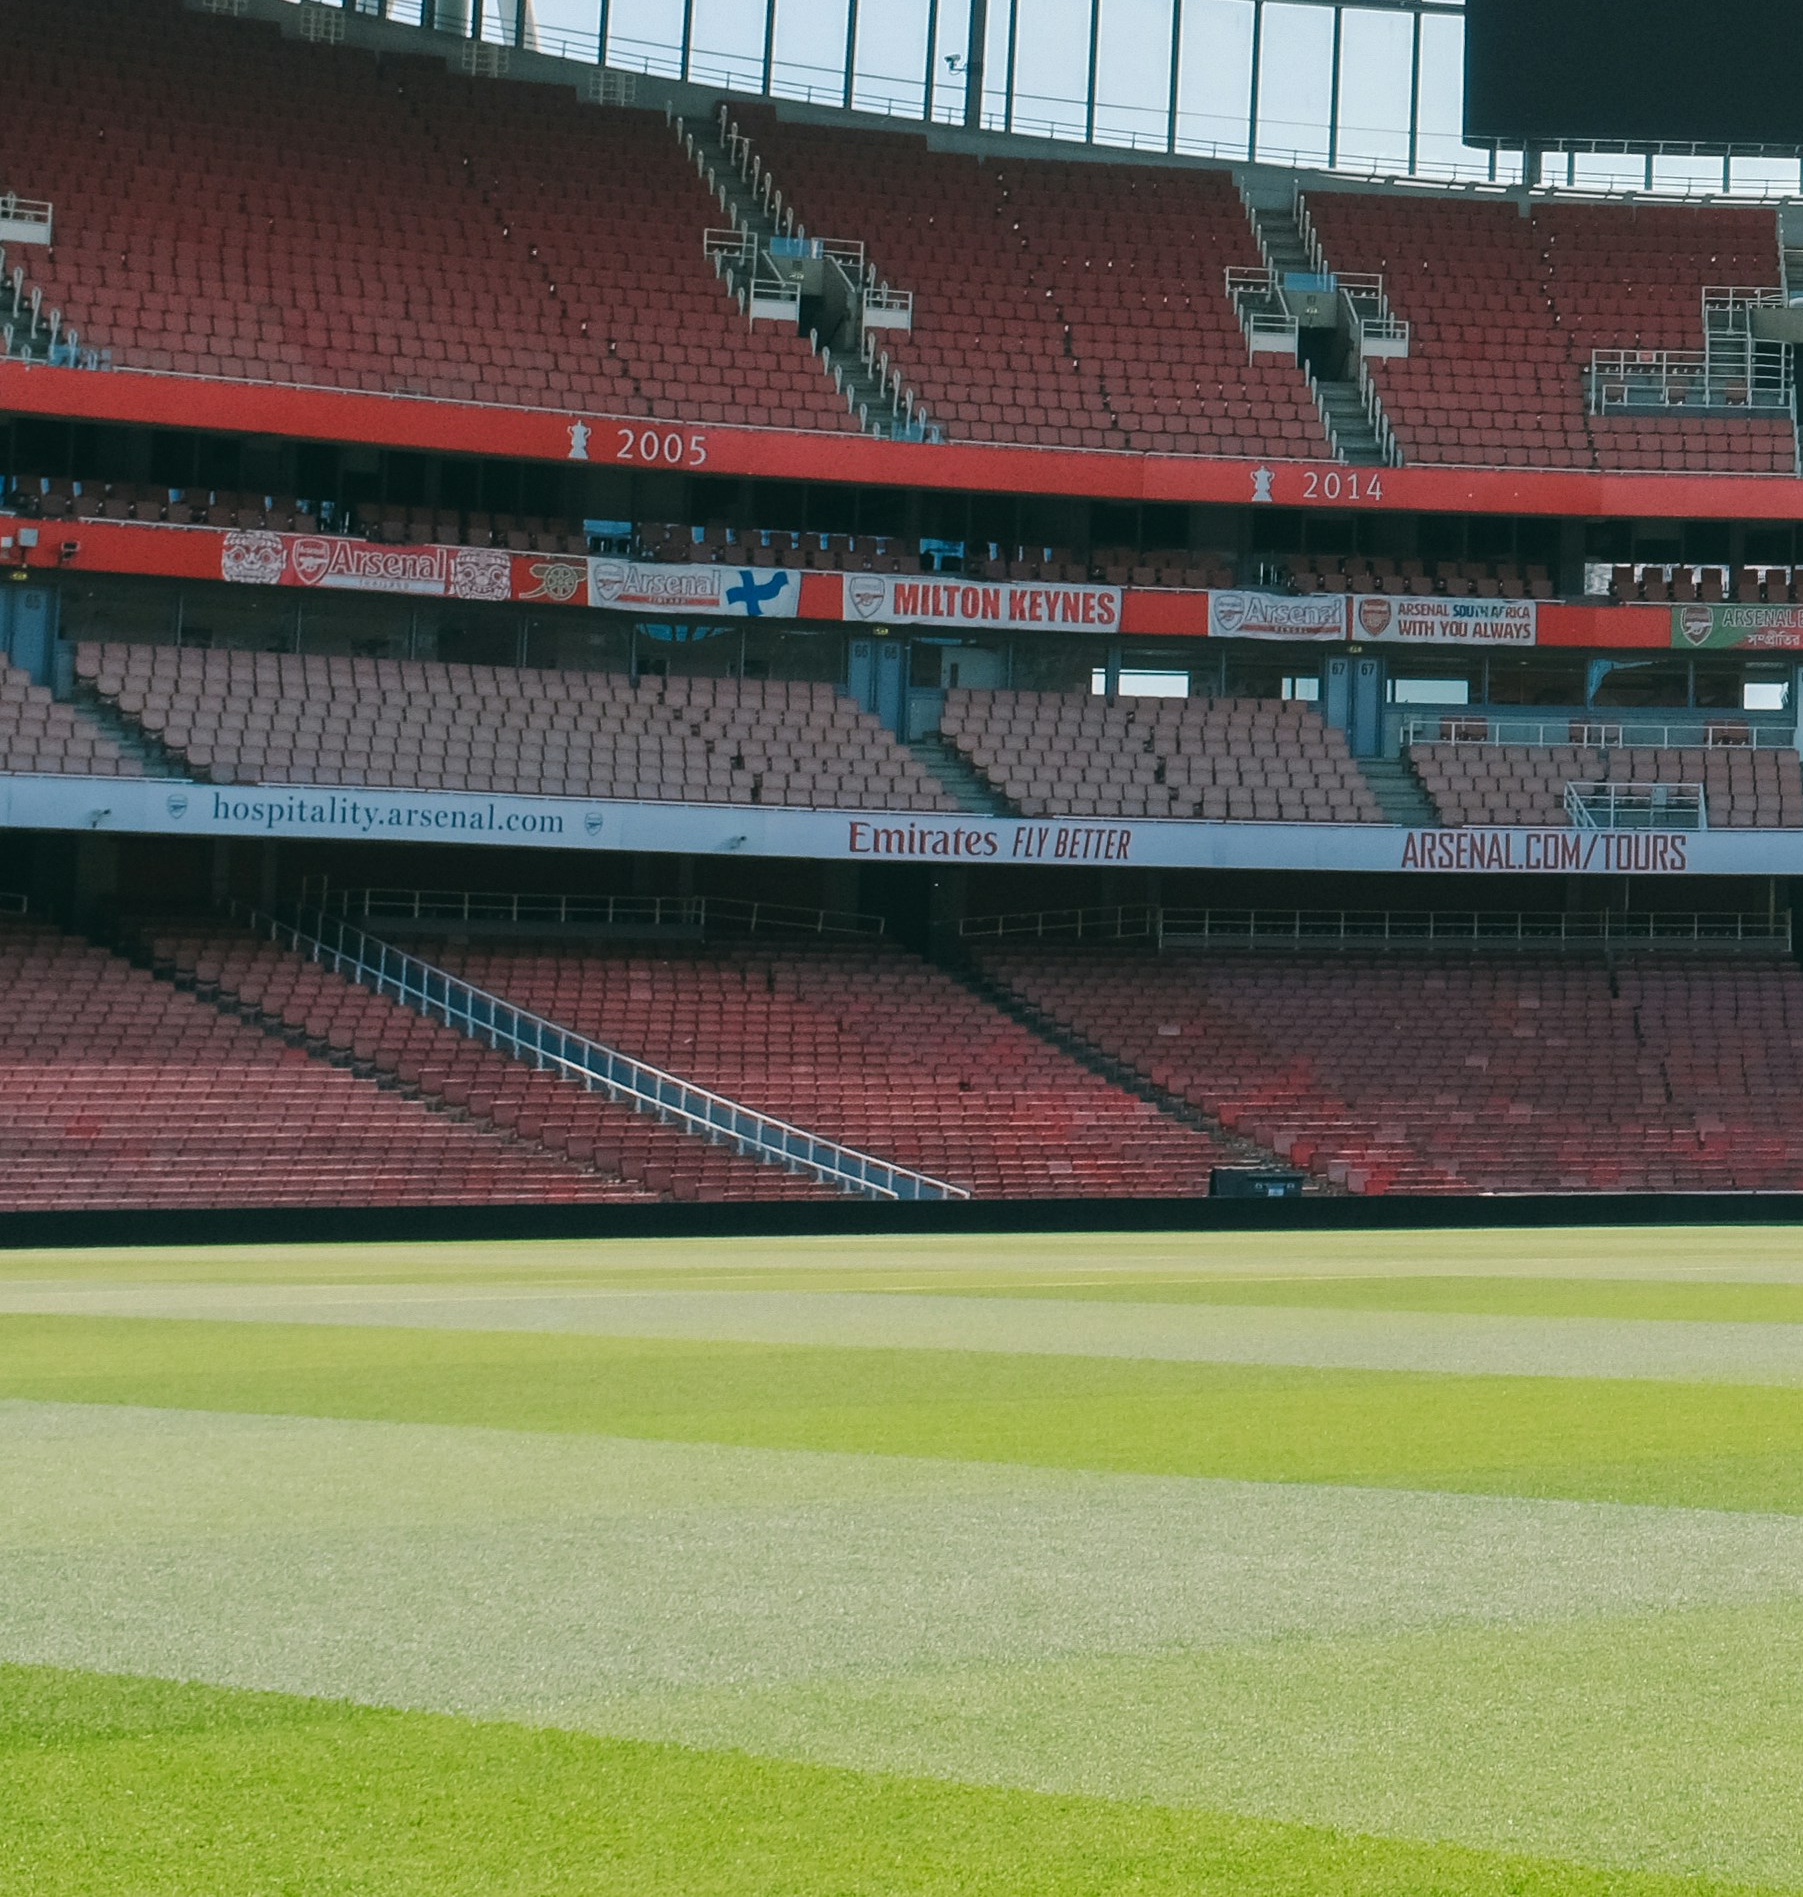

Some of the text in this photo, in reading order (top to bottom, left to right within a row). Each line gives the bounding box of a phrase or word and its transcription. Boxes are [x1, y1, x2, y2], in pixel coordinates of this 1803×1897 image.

[617, 429, 707, 465] 2005
[1303, 472, 1383, 500] 2014
[330, 540, 447, 581] Arsenal
[622, 566, 720, 595] Arsenal
[894, 583, 1115, 625] MILTON KEYNES
[1244, 600, 1342, 625] Arsenal
[1398, 604, 1530, 618] ARSENAL SOUTH AFRICA
[1721, 608, 1796, 628] ARSENAL
[1398, 619, 1531, 639] WITH YOU ALWAYS
[1332, 663, 1345, 675] 67
[1361, 663, 1374, 675] 67
[212, 791, 565, 834] hospitality.arsenal.com
[849, 821, 1131, 860] Emirates FLY BETTER
[1401, 832, 1687, 871] ARSENAL.COM/TOURS
